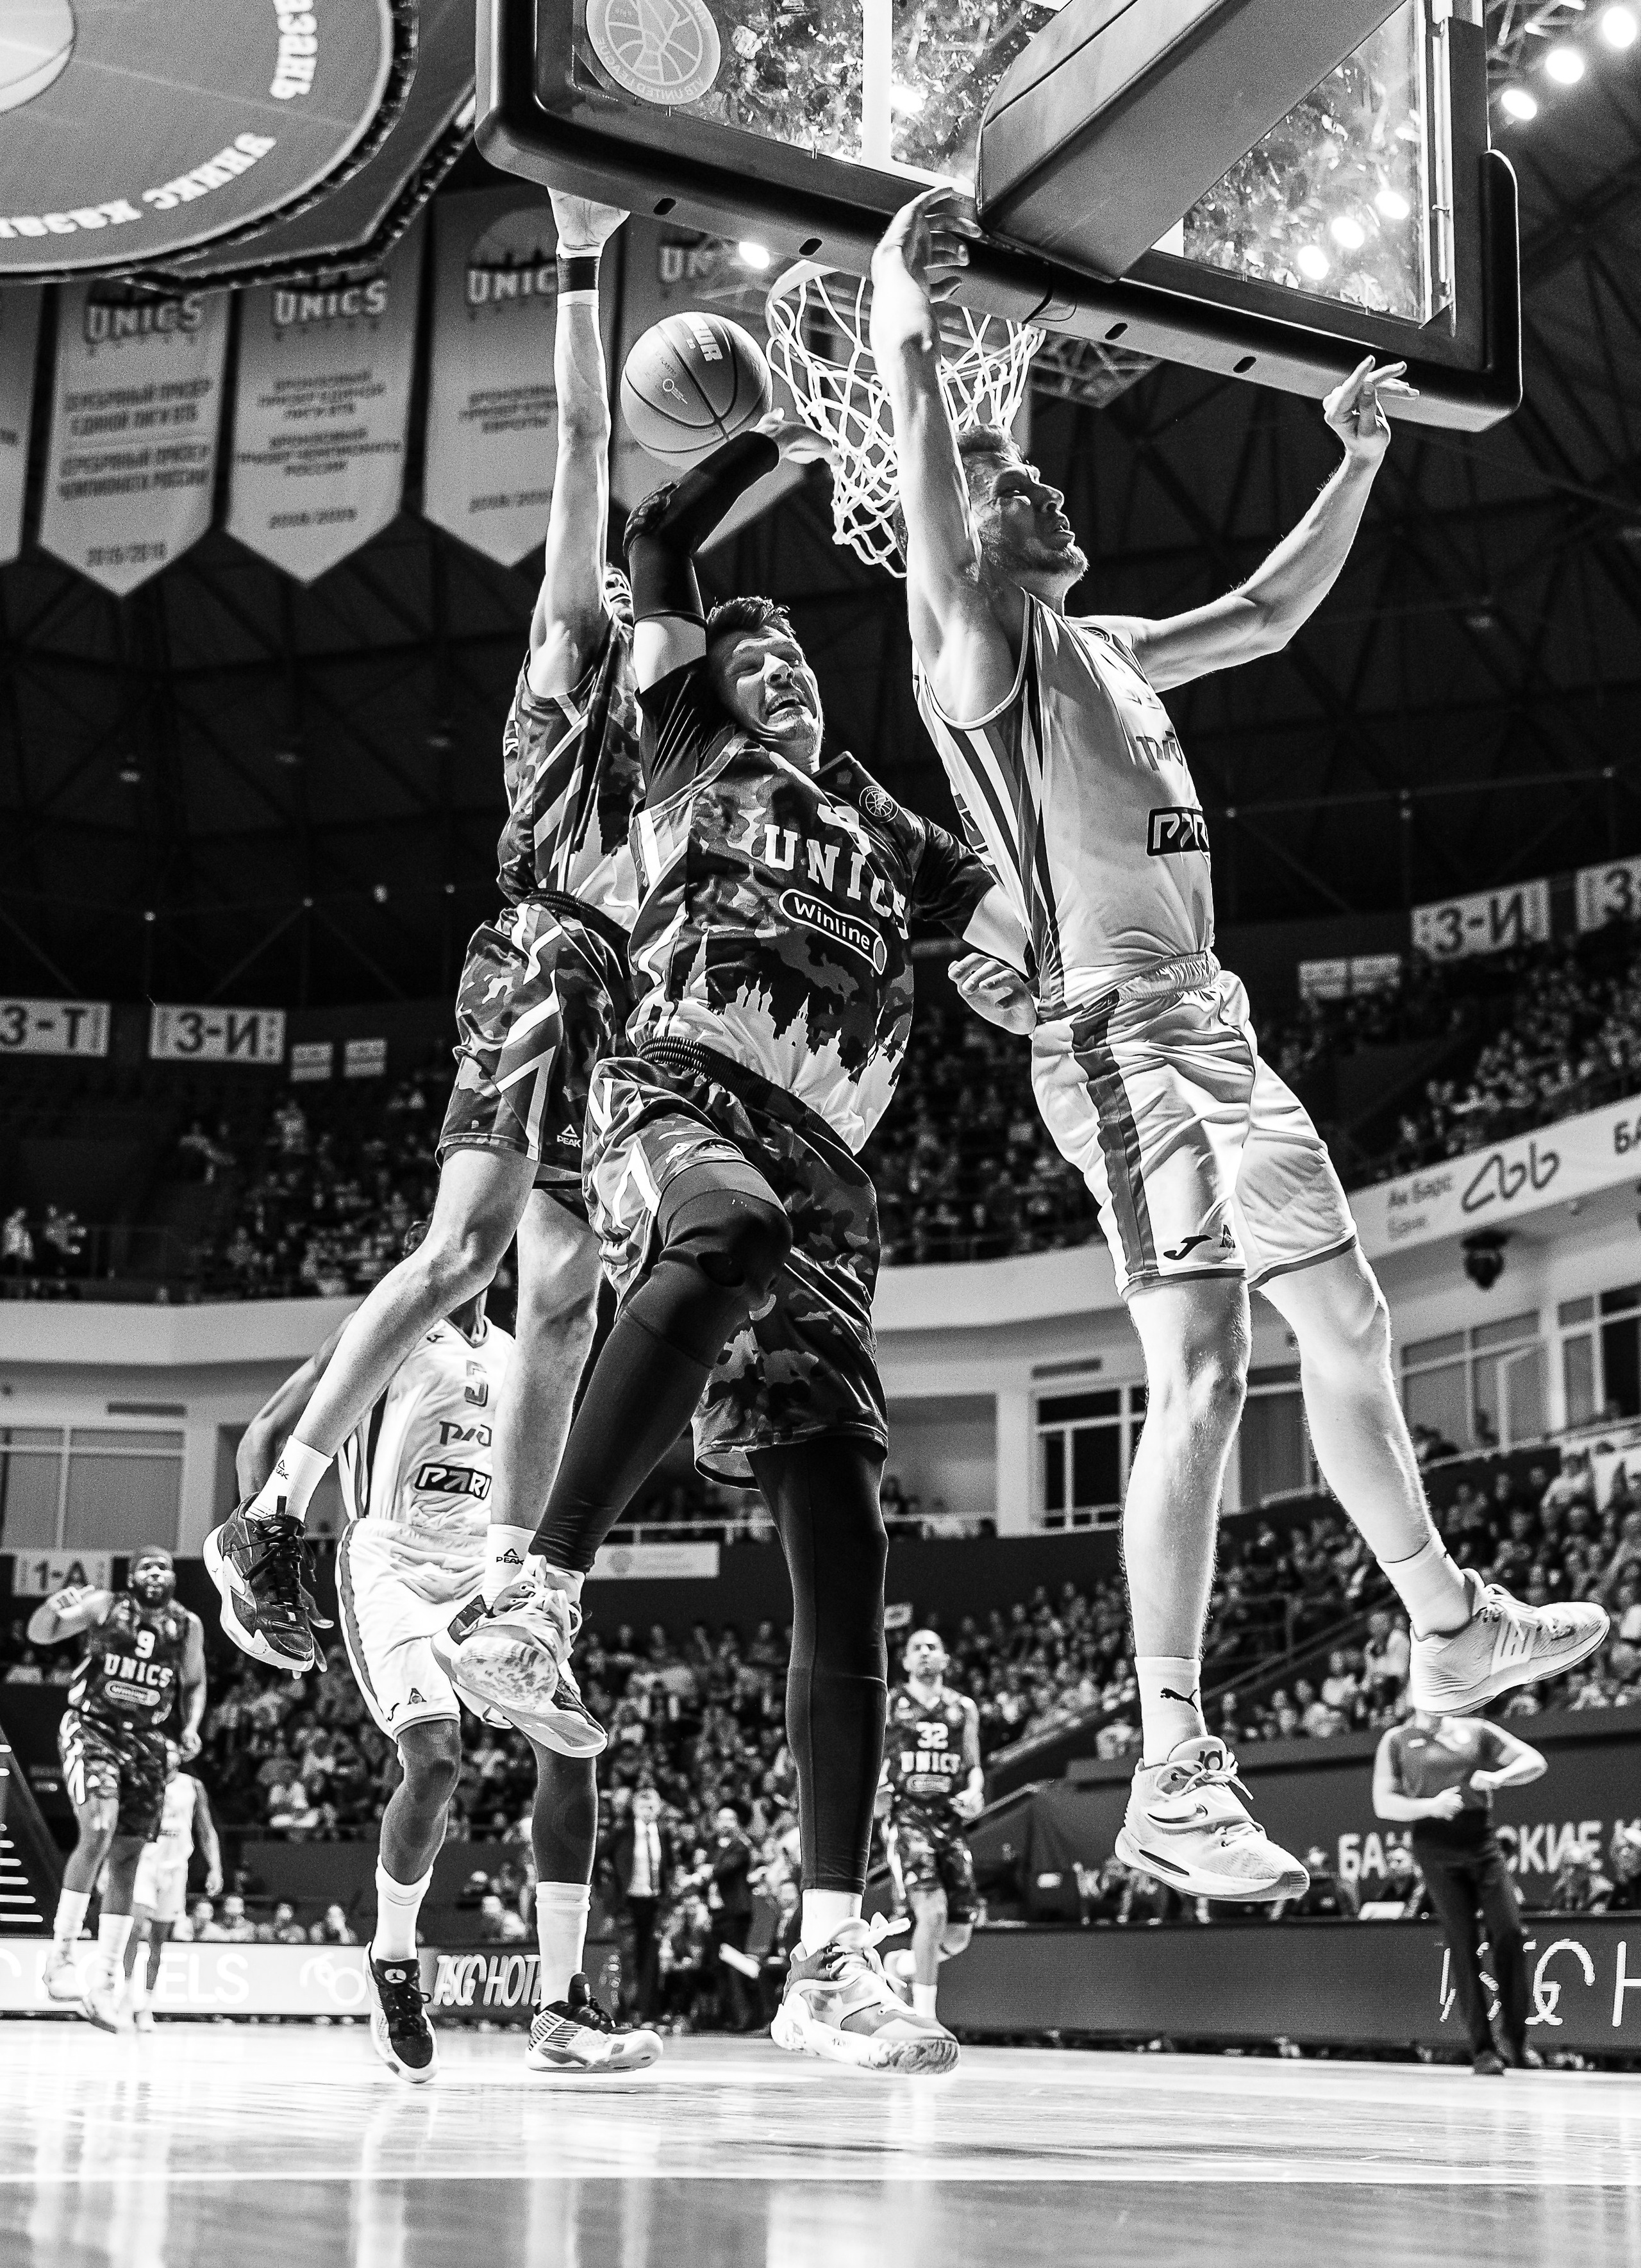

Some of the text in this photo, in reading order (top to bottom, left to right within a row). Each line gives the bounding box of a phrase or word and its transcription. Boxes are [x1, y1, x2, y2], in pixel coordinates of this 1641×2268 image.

[467, 262, 556, 304] UNIC
[275, 278, 388, 323] UNICS
[87, 297, 203, 339] UNICS
[764, 824, 909, 940] UNICS
[556, 1134, 581, 1148] PEAK
[496, 1556, 525, 1565] PEAK
[135, 1630, 156, 1659] 9
[103, 1652, 174, 1688] UNICS
[915, 1721, 949, 1749] 32
[900, 1750, 962, 1774] UNICS
